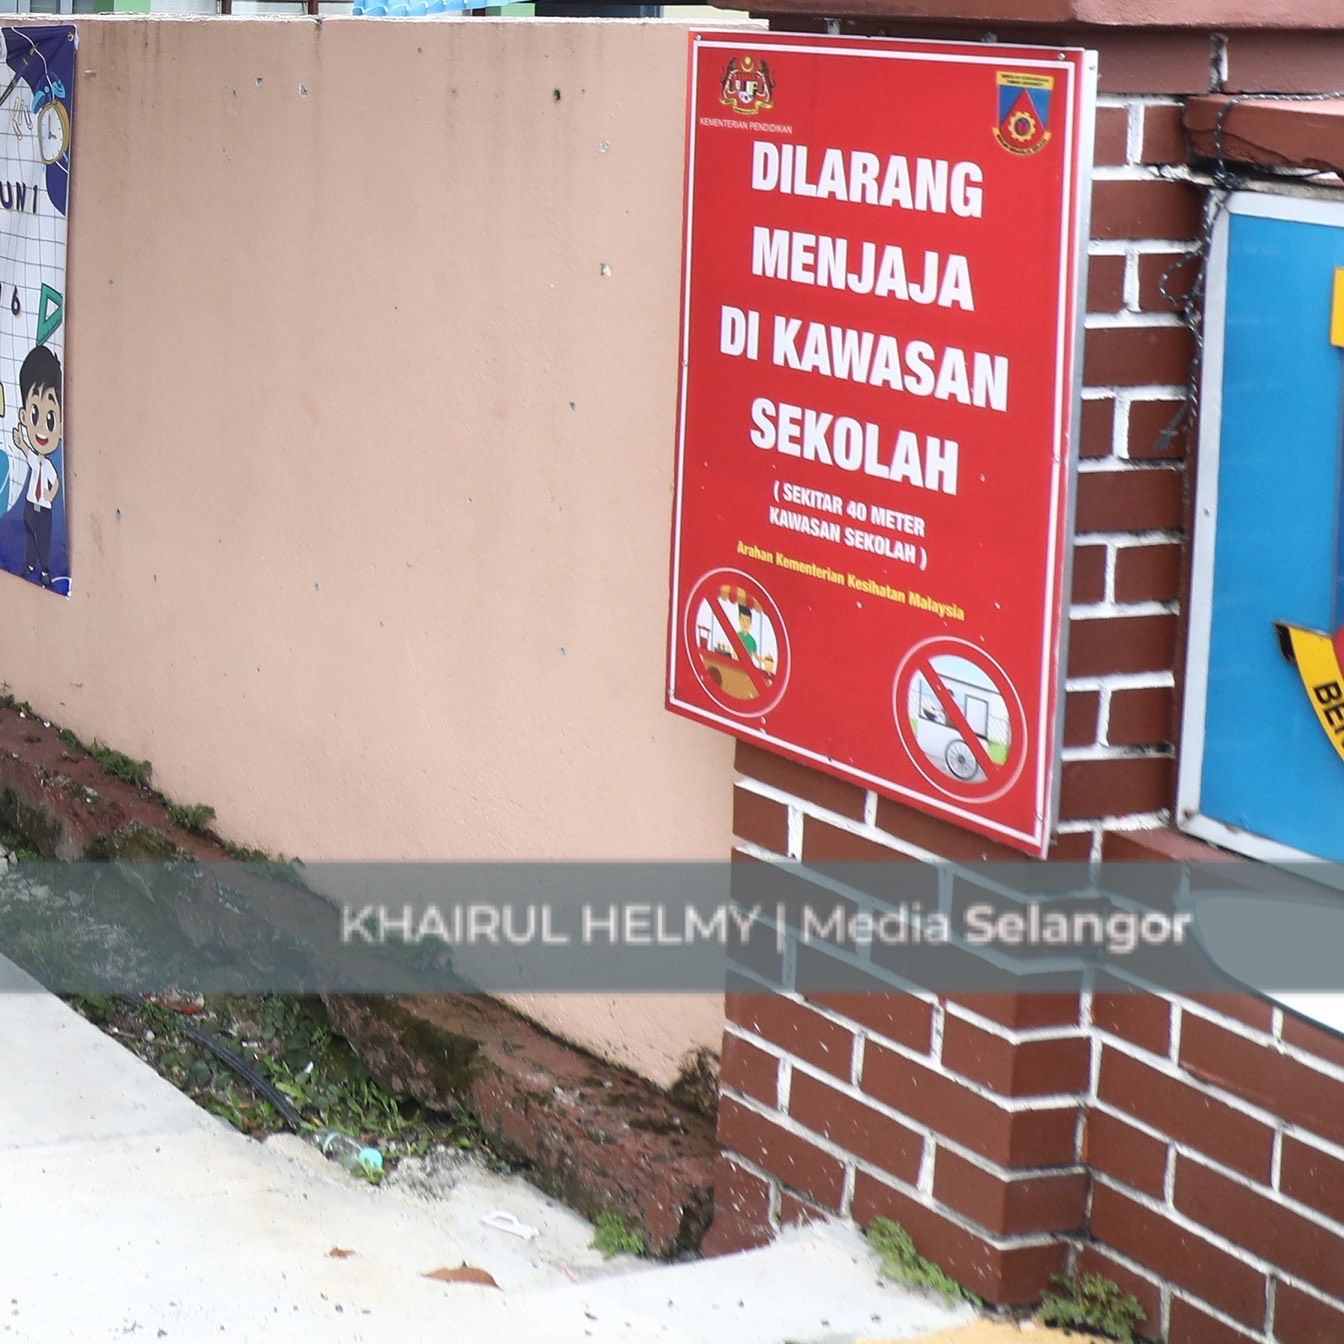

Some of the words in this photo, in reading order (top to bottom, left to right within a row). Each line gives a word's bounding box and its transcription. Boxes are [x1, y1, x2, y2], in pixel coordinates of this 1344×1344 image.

[699, 117, 750, 131] KEMENTERIAN
[749, 121, 793, 134] PENDIDIKAN
[31, 184, 39, 214] 1
[751, 140, 984, 219] DILARANG
[11, 285, 22, 317] 6
[751, 225, 975, 312] MENJAJA
[720, 304, 760, 361] DI
[772, 314, 1009, 412] KAWASAN
[749, 396, 960, 496] SEKOLAH
[769, 505, 841, 544] KAWASAN
[844, 527, 916, 565] SEKOLAH
[782, 482, 843, 516] SEKITAR
[846, 500, 867, 522] 40
[870, 504, 926, 537] METER
[736, 540, 774, 563] Arahan
[775, 551, 846, 586] Kementerian
[847, 573, 906, 604] Kesihatan
[908, 591, 966, 622] Malaysia
